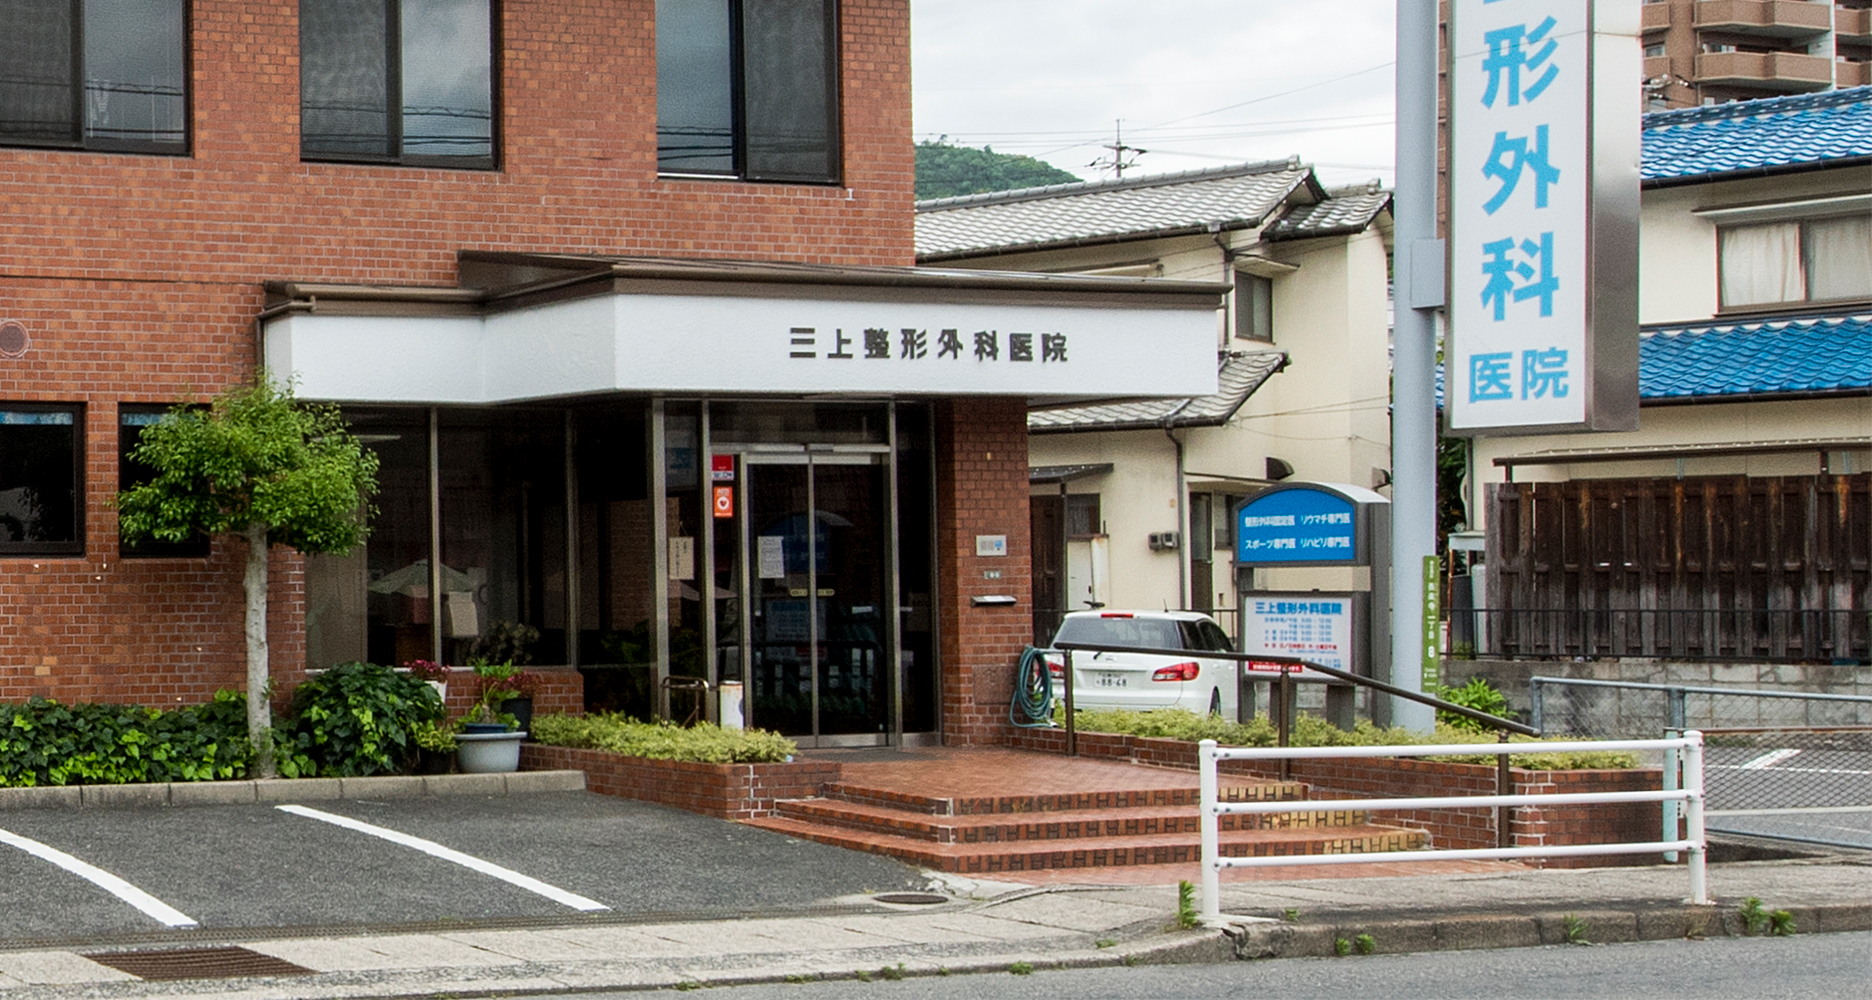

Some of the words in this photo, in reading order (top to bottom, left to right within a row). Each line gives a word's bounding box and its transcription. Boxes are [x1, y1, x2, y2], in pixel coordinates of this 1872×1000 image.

[789, 327, 1068, 362] 三上整形外科医院
[1468, 346, 1569, 404] 医院
[1245, 537, 1296, 550] スポーツ専門医
